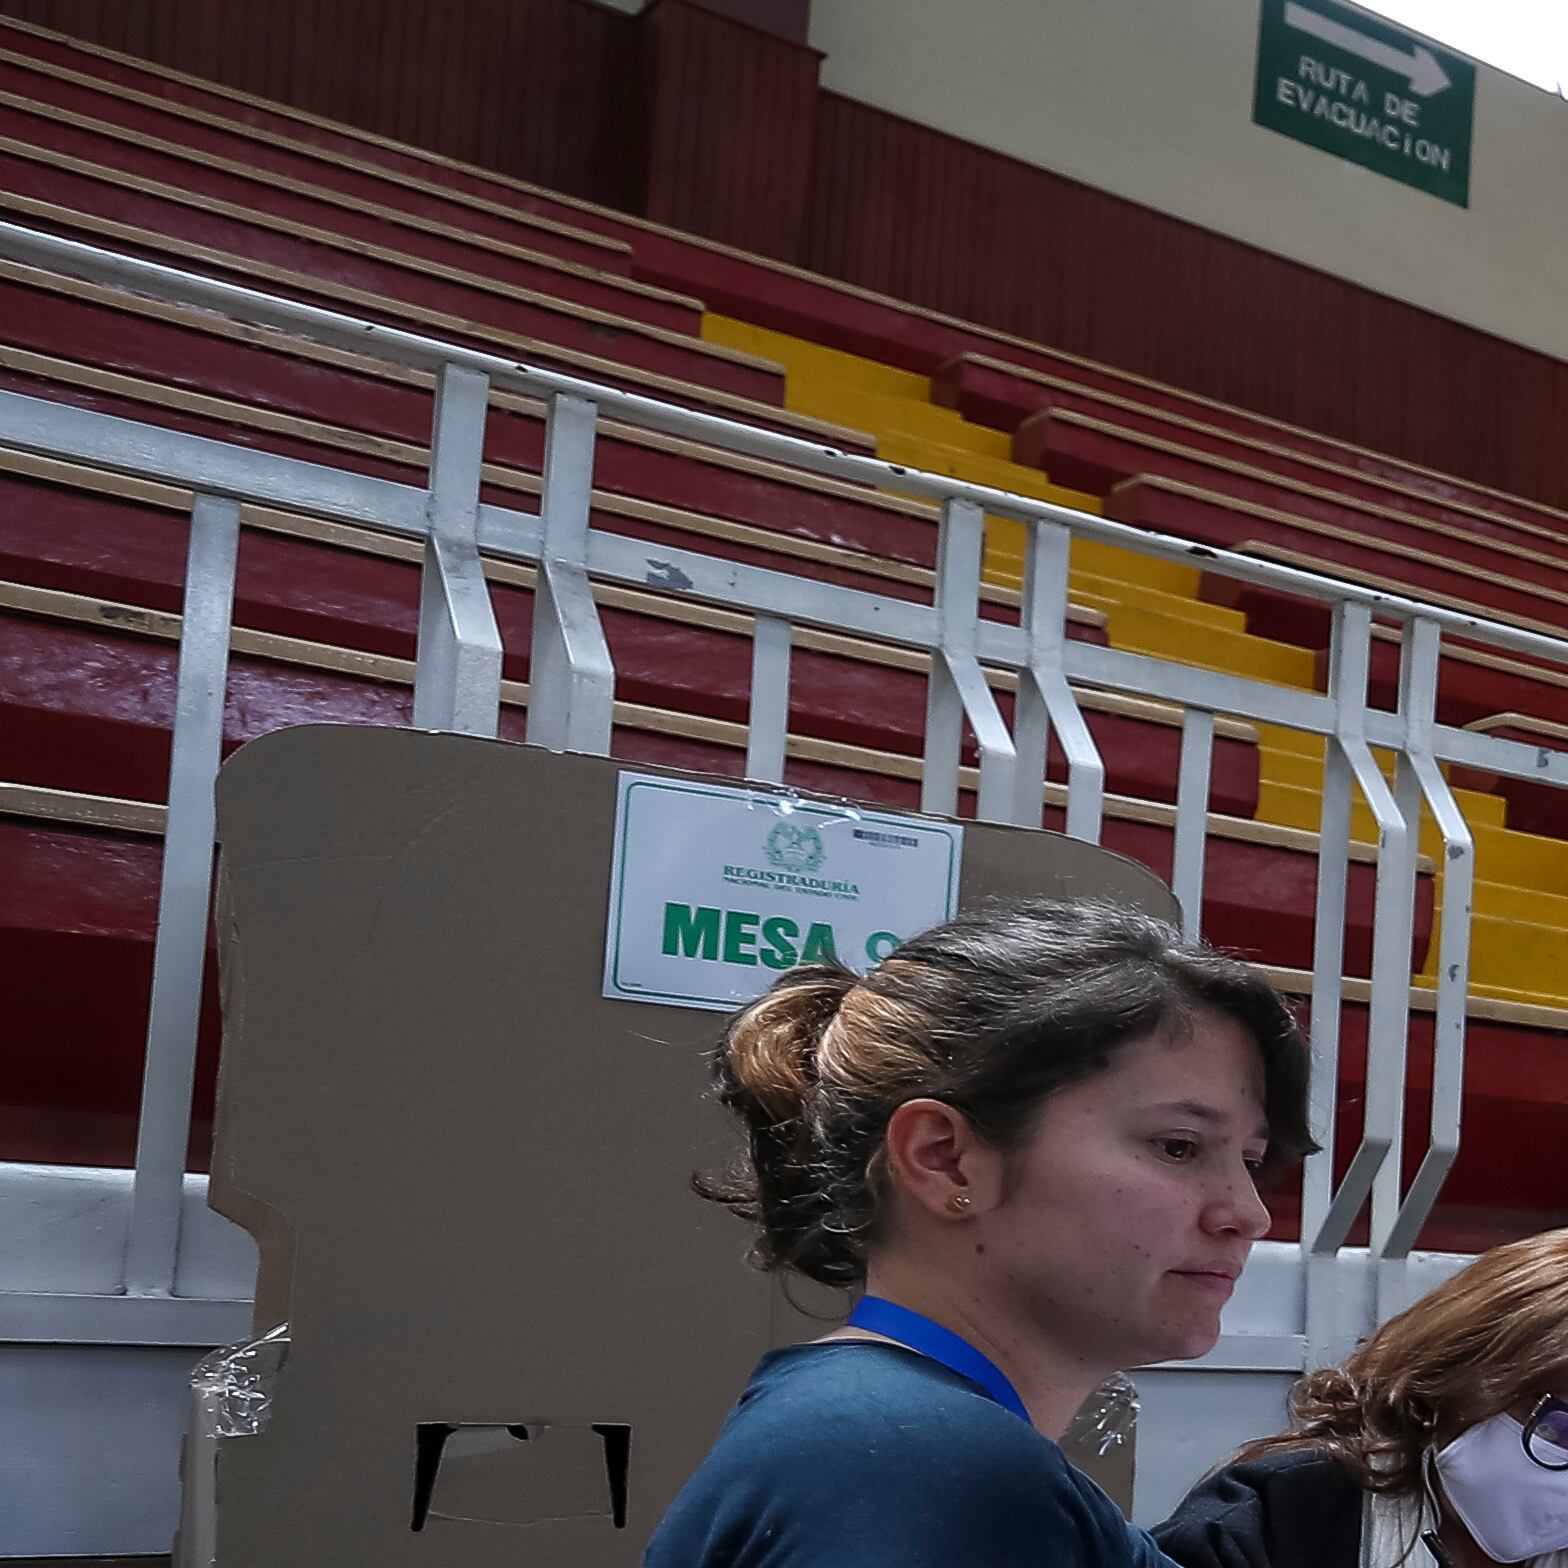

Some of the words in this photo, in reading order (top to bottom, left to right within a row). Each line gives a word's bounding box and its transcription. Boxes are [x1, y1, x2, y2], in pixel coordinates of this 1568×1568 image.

[1276, 76, 1451, 170] EVACUACION
[1299, 54, 1370, 104] RUTA
[1384, 91, 1421, 127] DE
[724, 865, 859, 894] REGISTRADURÍA
[662, 902, 836, 970] MESA
